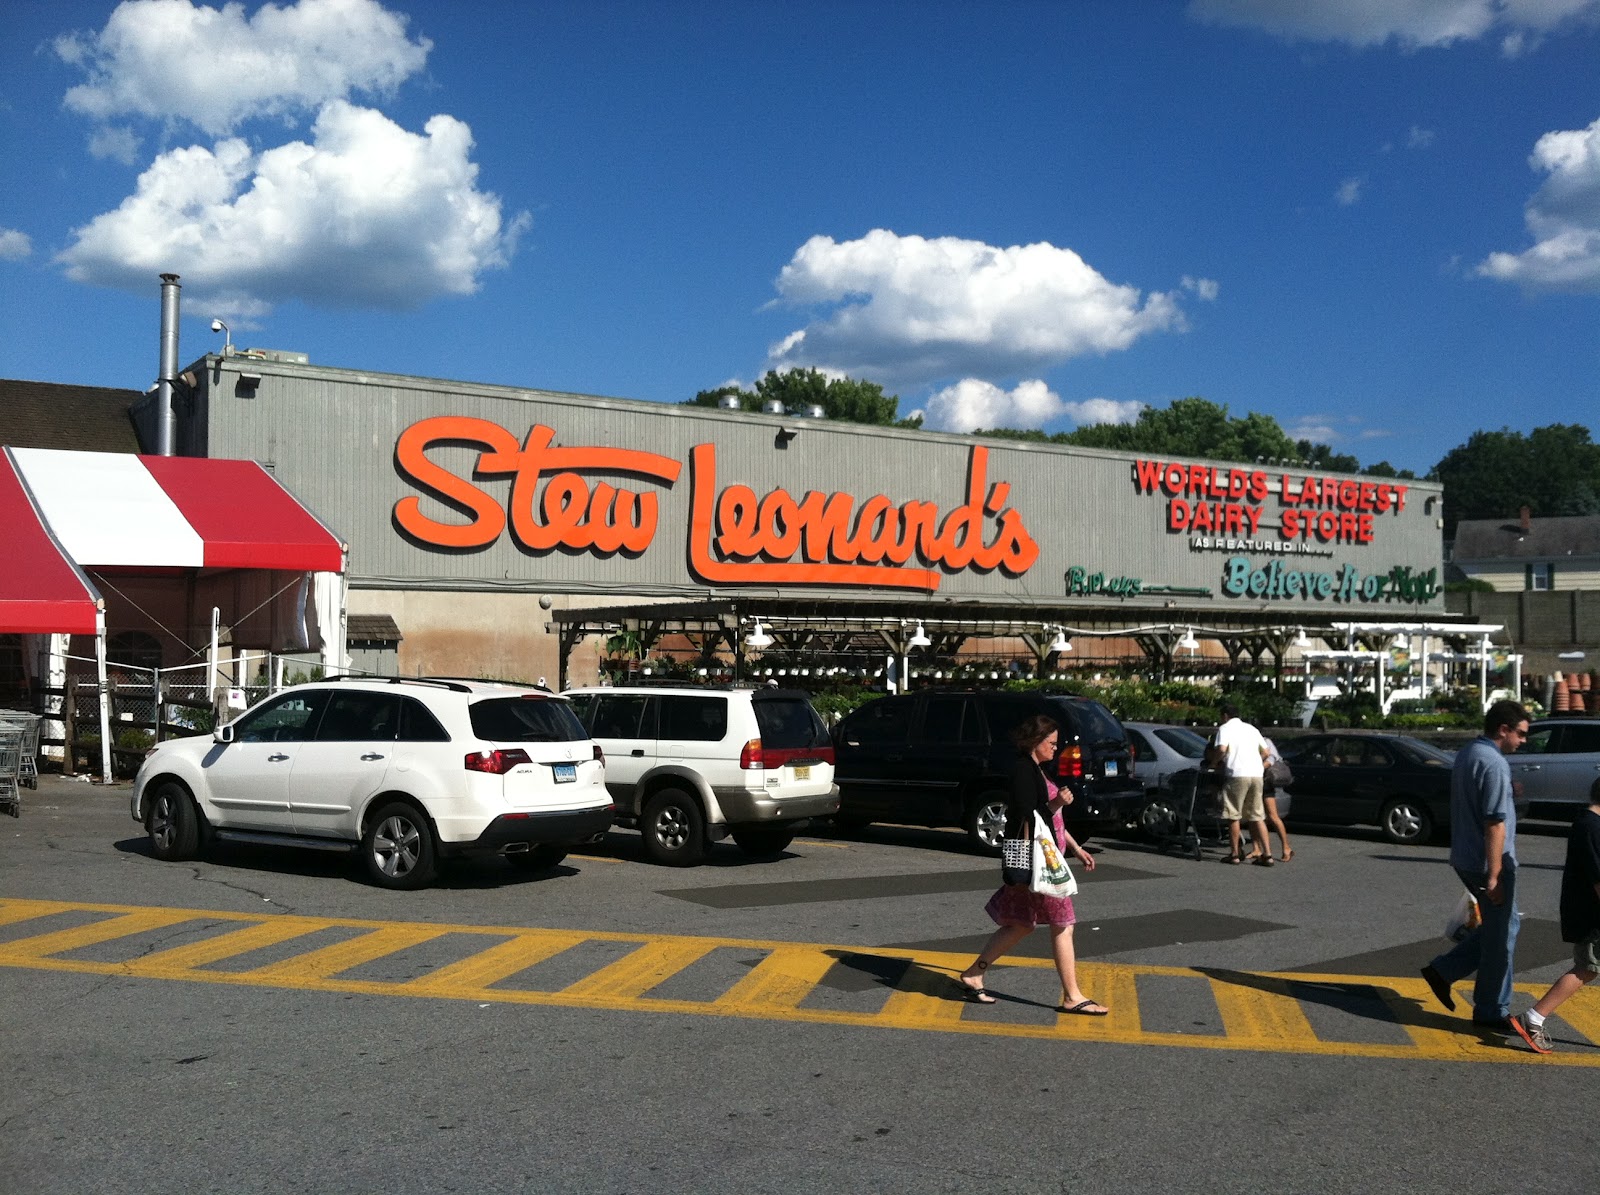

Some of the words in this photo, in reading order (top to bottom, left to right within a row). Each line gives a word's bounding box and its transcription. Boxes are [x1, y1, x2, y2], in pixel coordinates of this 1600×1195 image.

[394, 416, 682, 554] Stew
[689, 441, 1040, 592] Leonard's
[1136, 460, 1269, 500] WORLDS
[1282, 474, 1408, 512] LARGEST
[1170, 500, 1264, 534] DAIRY
[1281, 509, 1374, 541] STORE
[1195, 537, 1210, 548] AS
[1215, 538, 1292, 552] FEATURED
[1226, 556, 1333, 597] Believe
[1338, 563, 1359, 599] It
[1364, 574, 1389, 600] or
